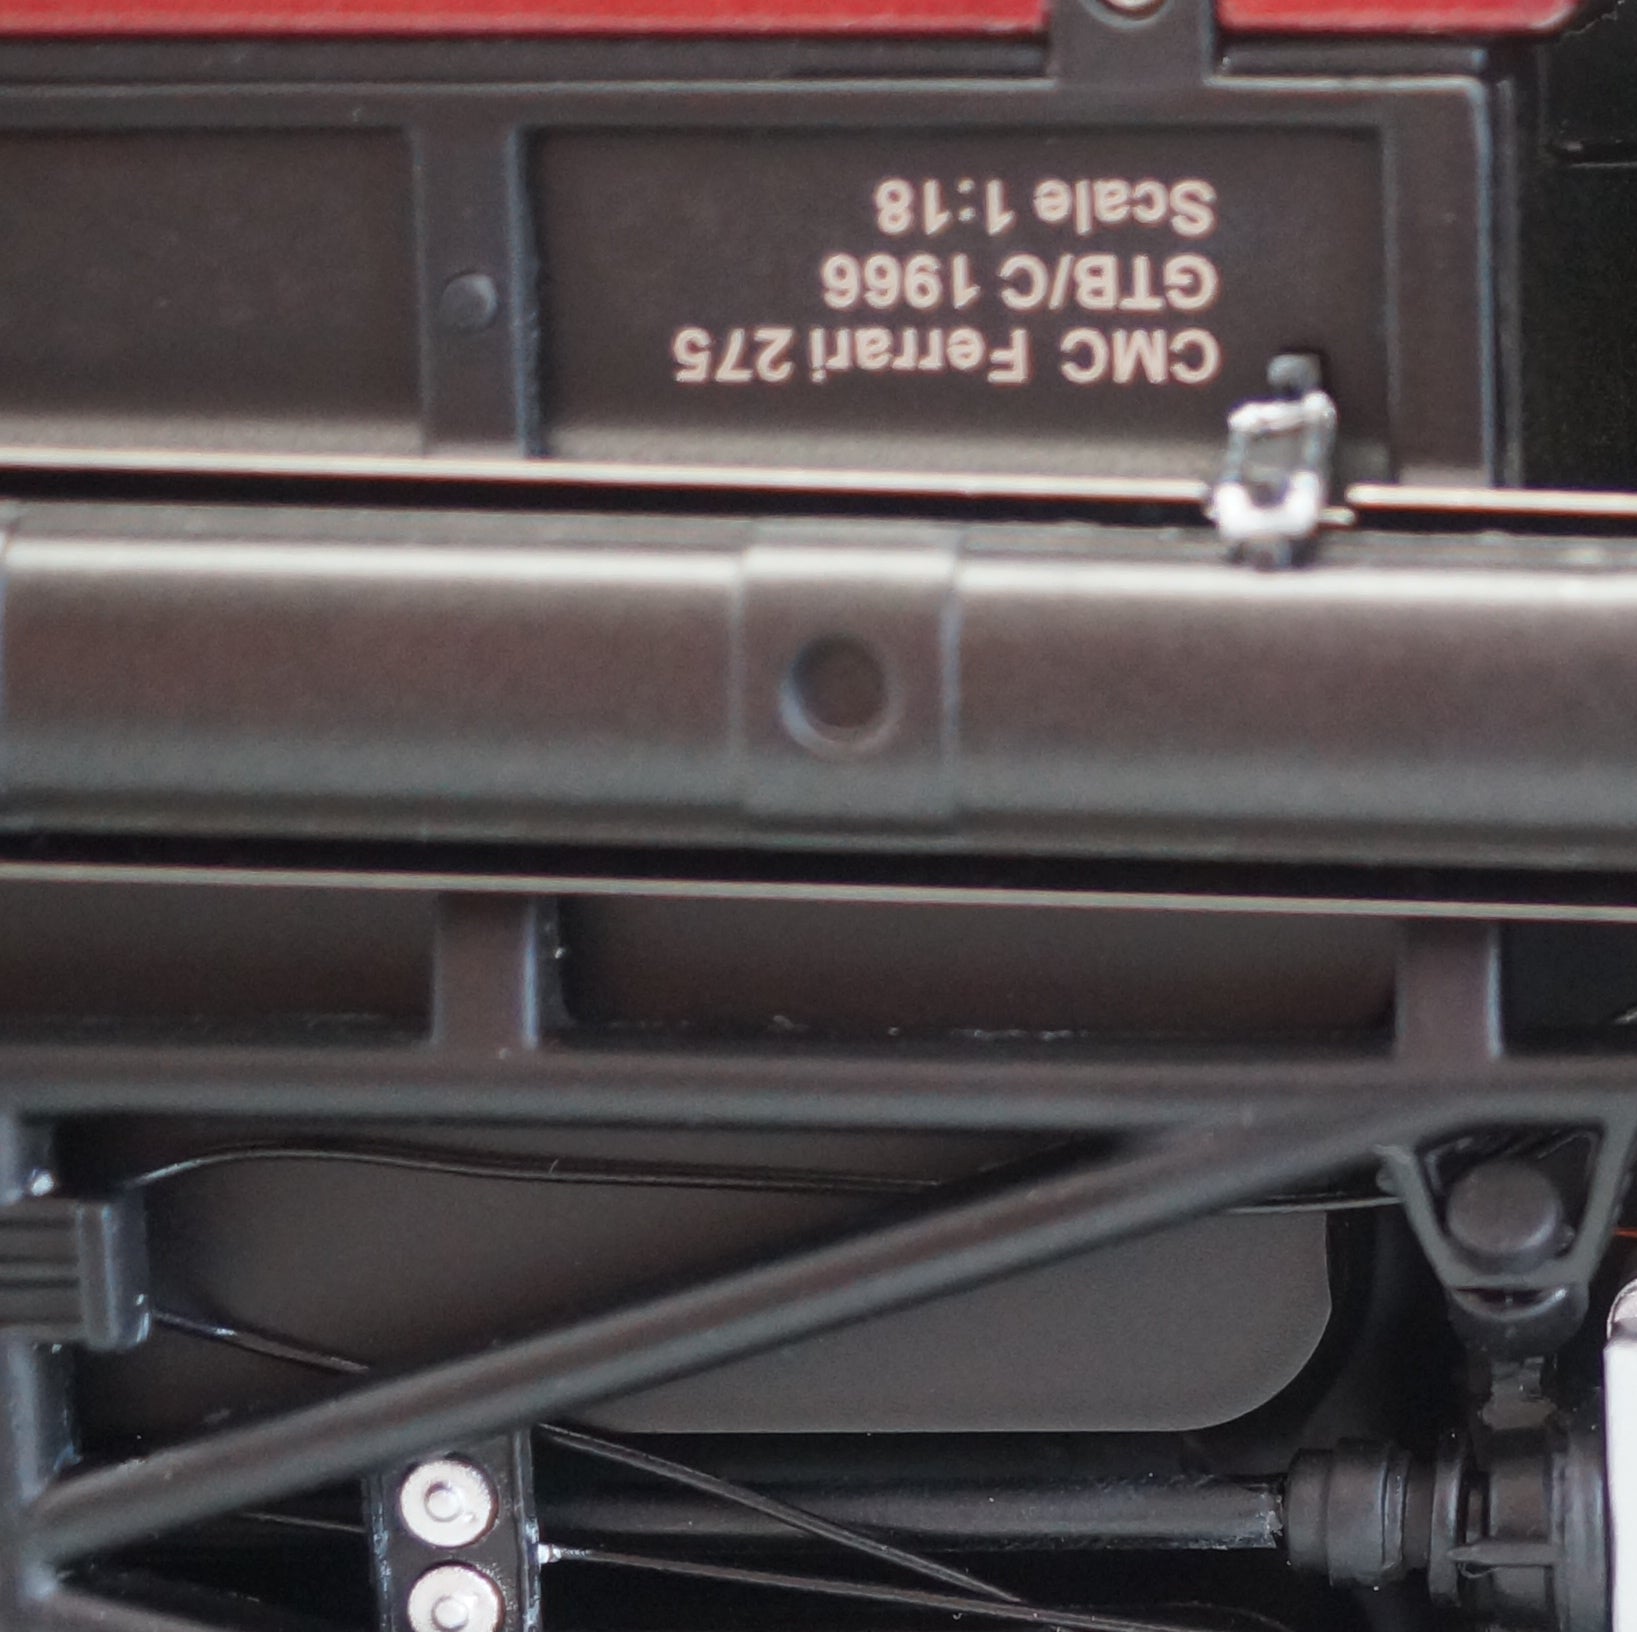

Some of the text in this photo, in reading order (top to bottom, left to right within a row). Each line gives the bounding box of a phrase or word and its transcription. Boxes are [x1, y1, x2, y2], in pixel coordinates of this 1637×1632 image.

[873, 178, 1216, 236] Scale 1:18
[821, 253, 1218, 310] GTB/C 1966
[673, 326, 1221, 384] CMC Ferrari 275
